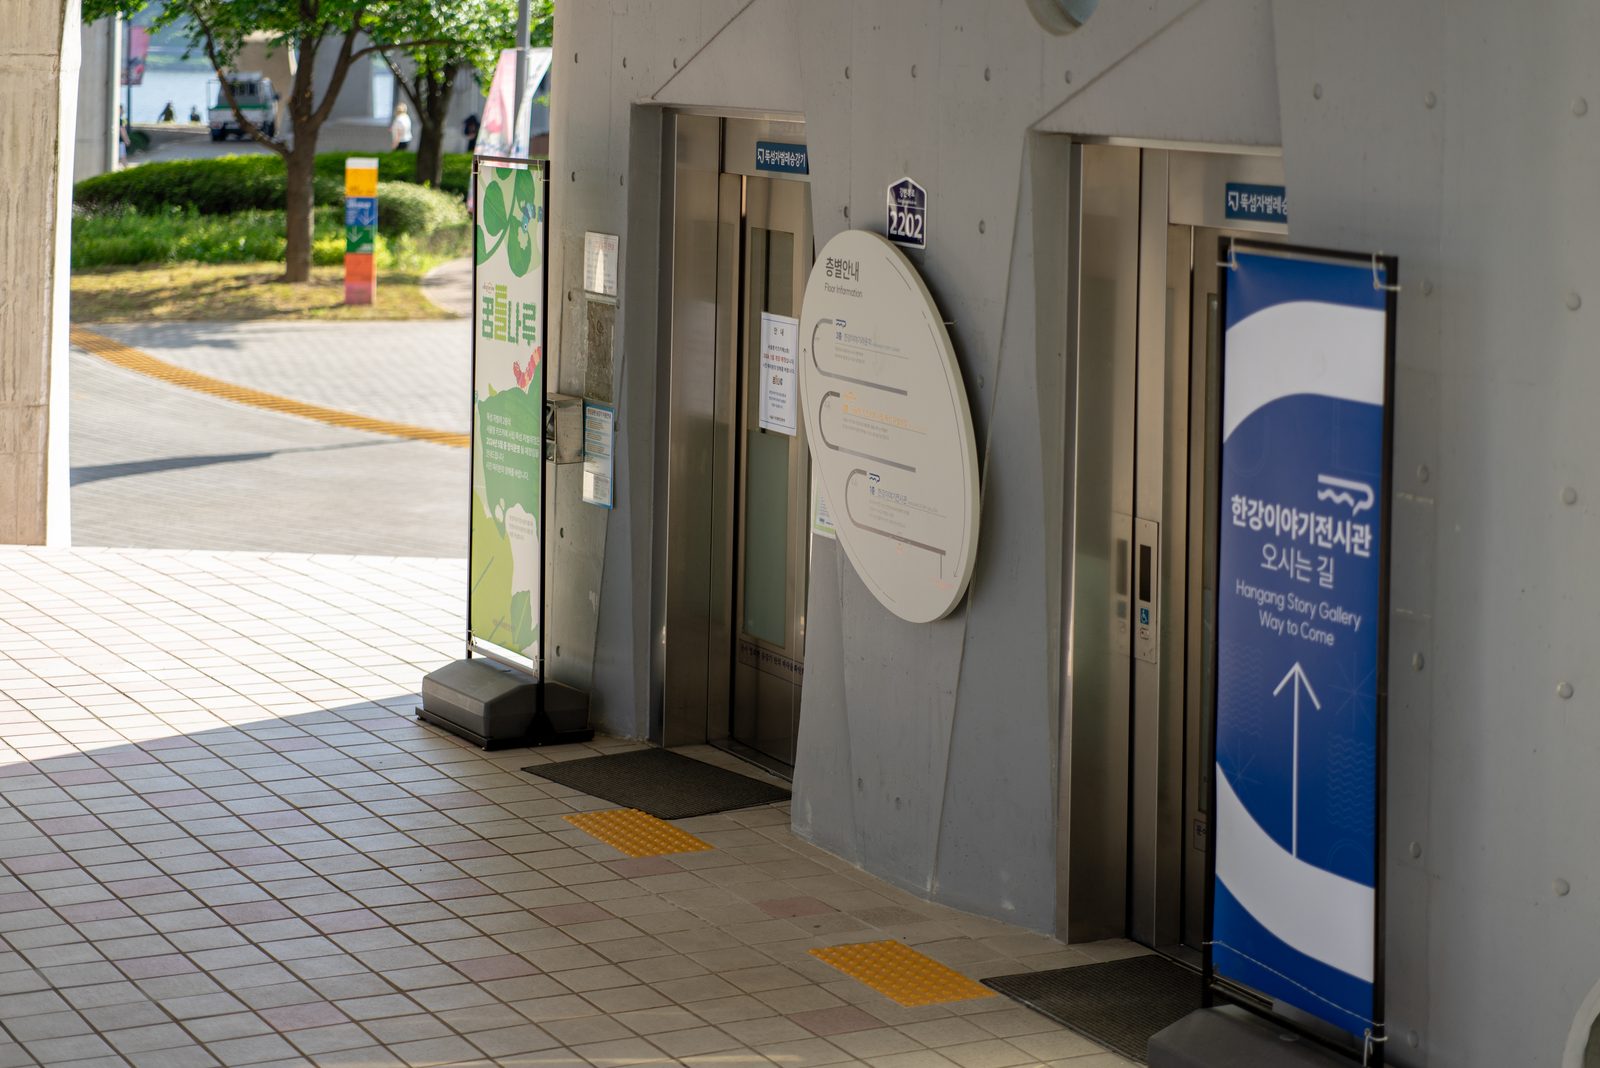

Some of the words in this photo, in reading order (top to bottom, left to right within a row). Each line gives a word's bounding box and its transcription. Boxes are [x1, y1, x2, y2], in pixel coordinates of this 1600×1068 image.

[764, 149, 806, 168] 뚝섬자벌레승강기
[889, 210, 923, 239] 2202
[825, 256, 860, 283] 층별안내
[824, 282, 836, 293] Floor
[836, 284, 864, 298] Information
[1231, 494, 1372, 558] 한강이야기전시관
[1260, 543, 1313, 583] 오시는
[1316, 555, 1335, 589] 길
[1235, 578, 1285, 612] Hangang
[1286, 592, 1317, 620] Story
[1318, 601, 1362, 633] Gallery
[1258, 609, 1285, 636] Way
[1286, 618, 1298, 636] to
[1300, 621, 1335, 646] Come
